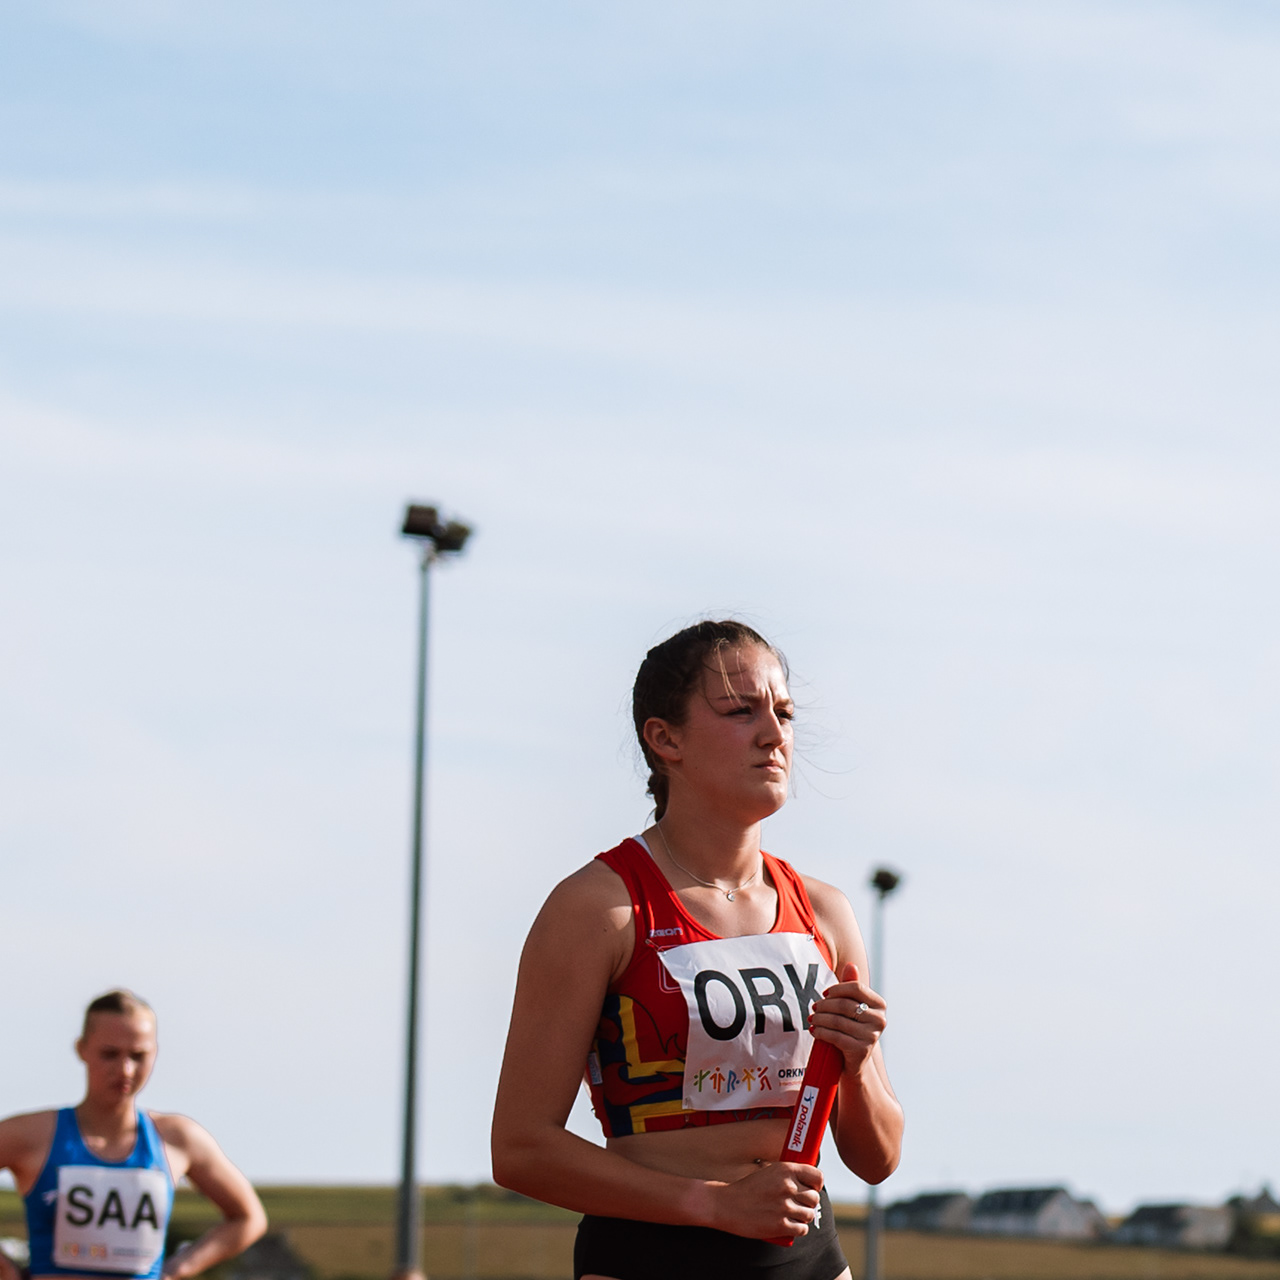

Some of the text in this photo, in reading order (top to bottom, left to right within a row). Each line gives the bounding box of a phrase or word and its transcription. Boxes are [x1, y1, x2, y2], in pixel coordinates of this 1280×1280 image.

[694, 963, 825, 1041] ORK
[778, 1067, 807, 1078] ORKN
[792, 1104, 809, 1147] polanik
[66, 1184, 158, 1230] SAA
